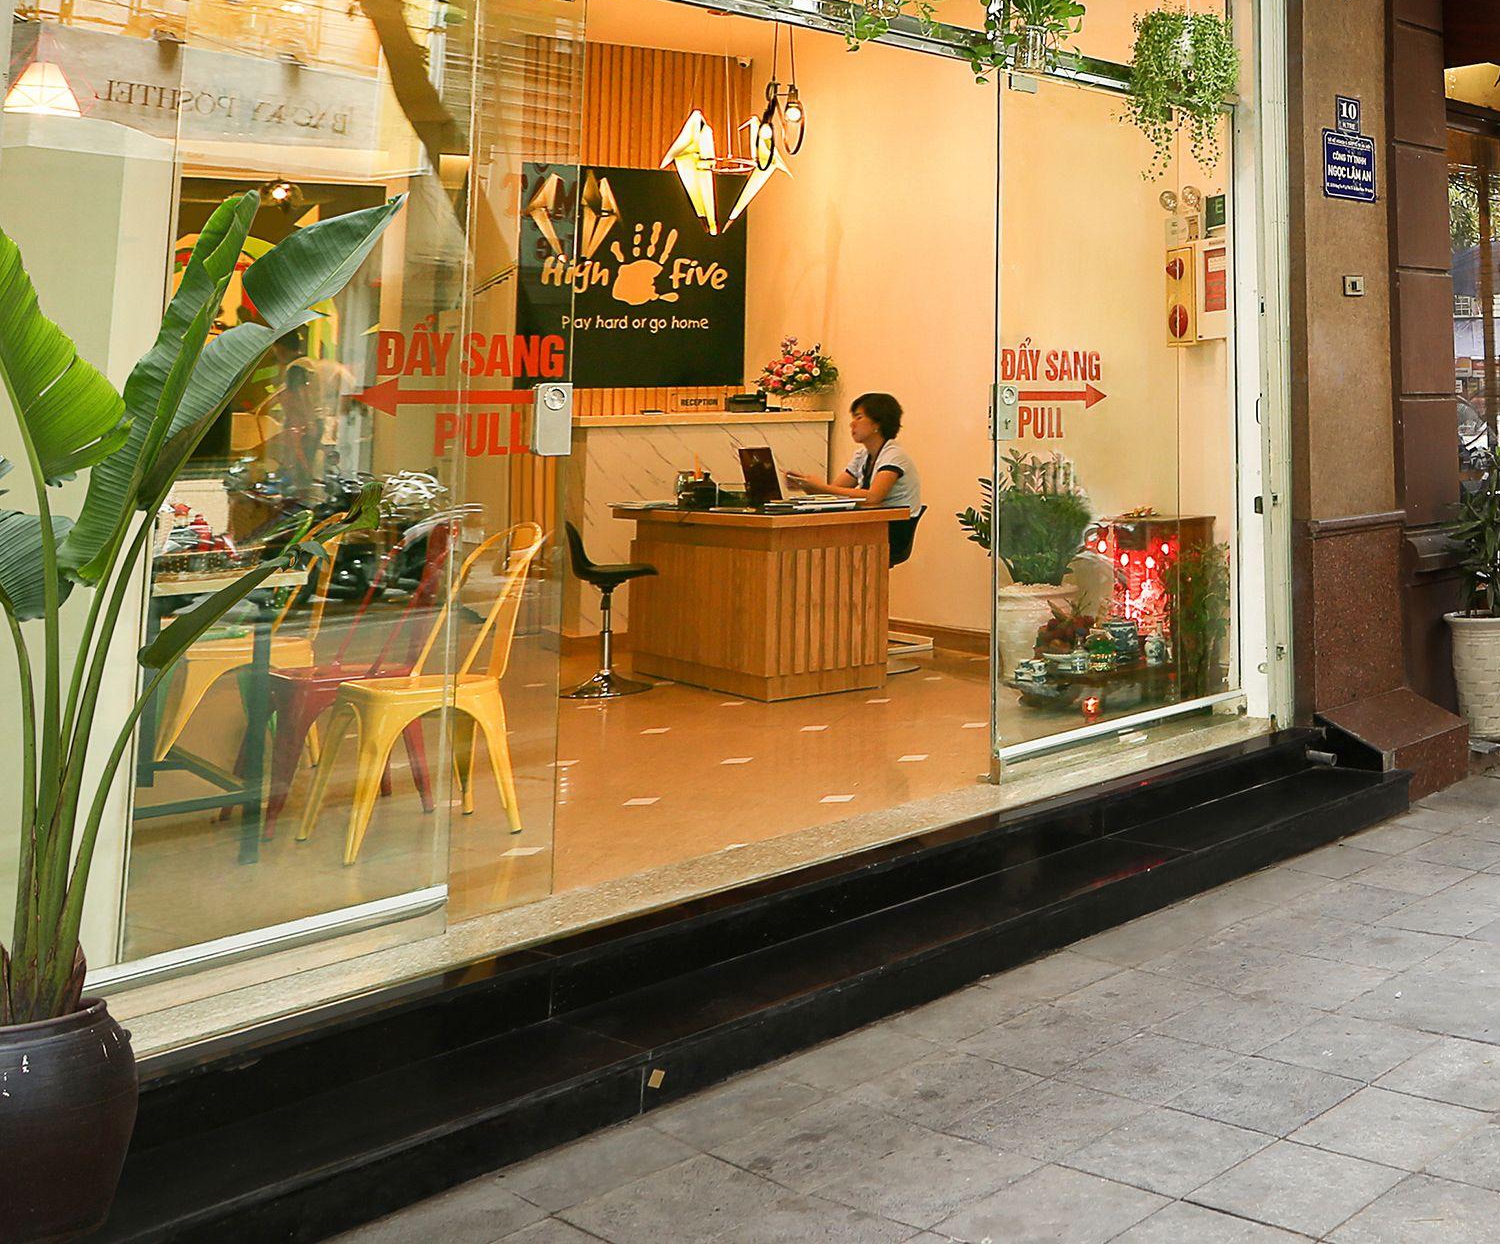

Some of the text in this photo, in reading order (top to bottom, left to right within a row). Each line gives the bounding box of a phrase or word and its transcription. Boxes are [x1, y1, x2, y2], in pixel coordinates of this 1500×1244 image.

[1340, 102, 1357, 120] 10
[541, 256, 610, 294] High
[561, 315, 710, 333] Pay hard or go home
[377, 314, 566, 378] ĐẨY SANG
[1001, 337, 1101, 381] ĐẨY SANG
[680, 398, 718, 407] RECEPTION
[434, 411, 530, 457] PULL
[1018, 406, 1064, 439] PULL
